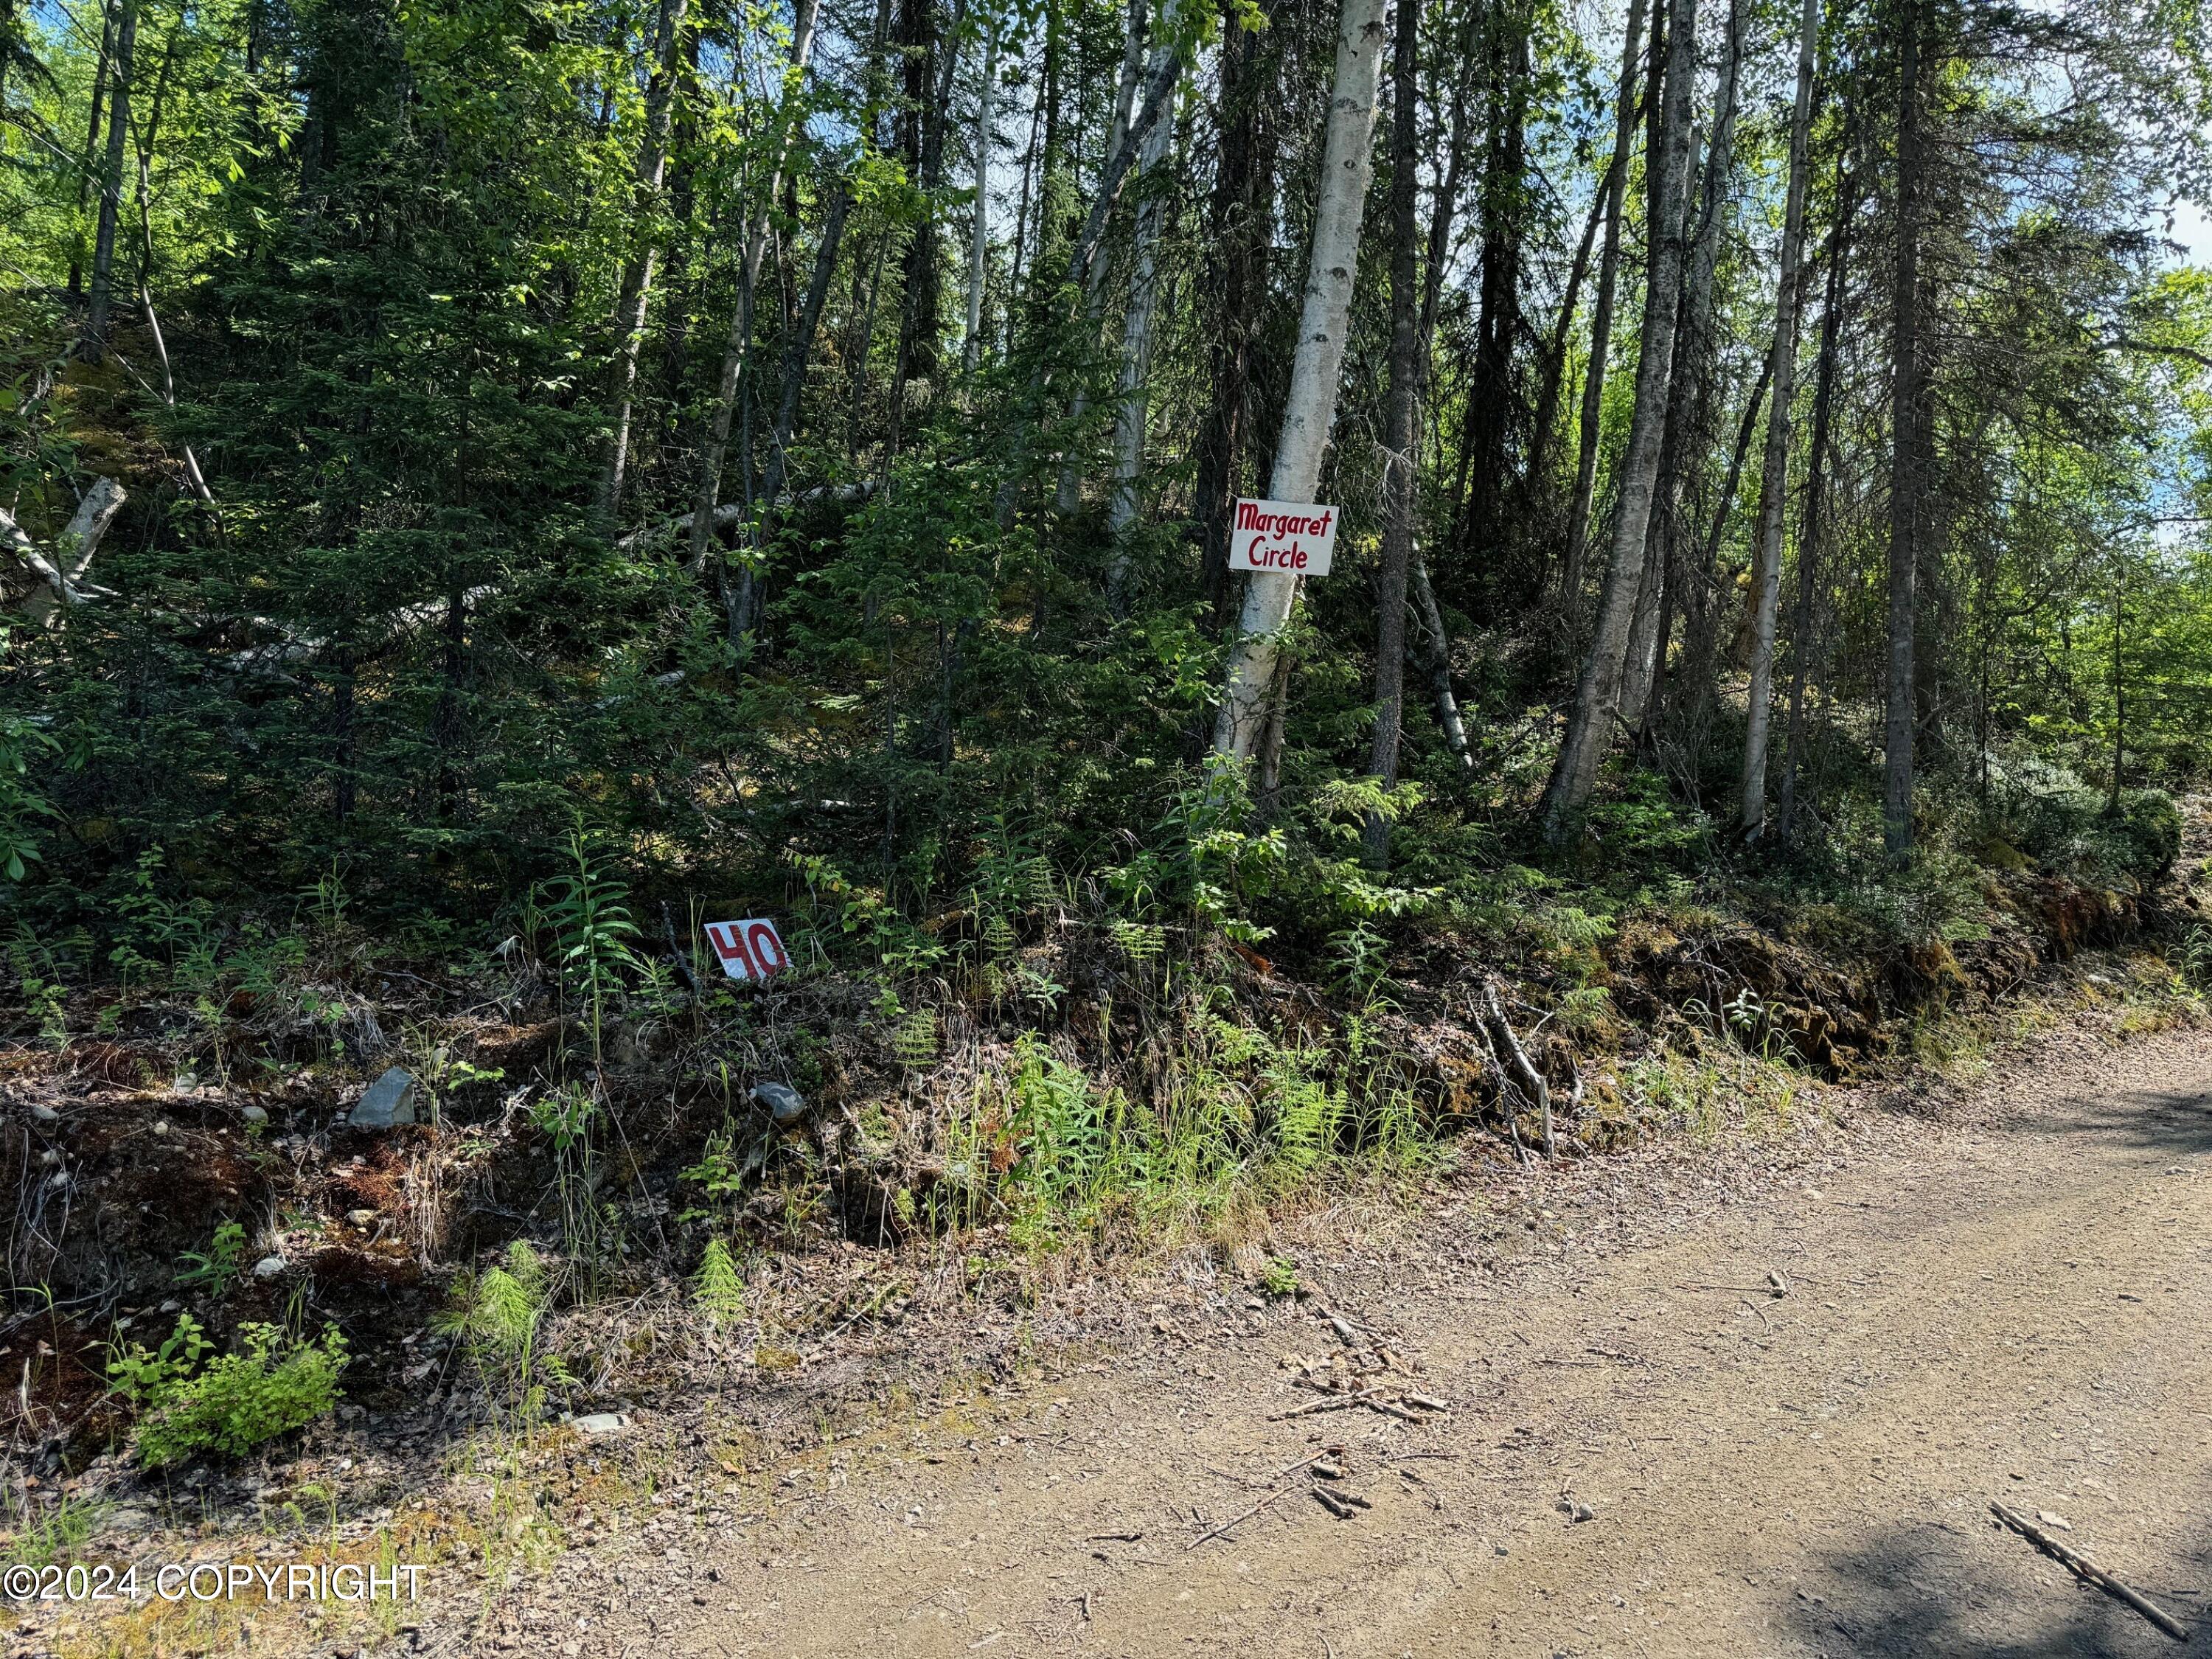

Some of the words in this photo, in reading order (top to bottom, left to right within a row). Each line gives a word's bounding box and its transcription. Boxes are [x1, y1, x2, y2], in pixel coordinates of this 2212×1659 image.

[1237, 502, 1332, 540] Margaret
[1248, 535, 1308, 568] Circle
[709, 923, 787, 979] 40
